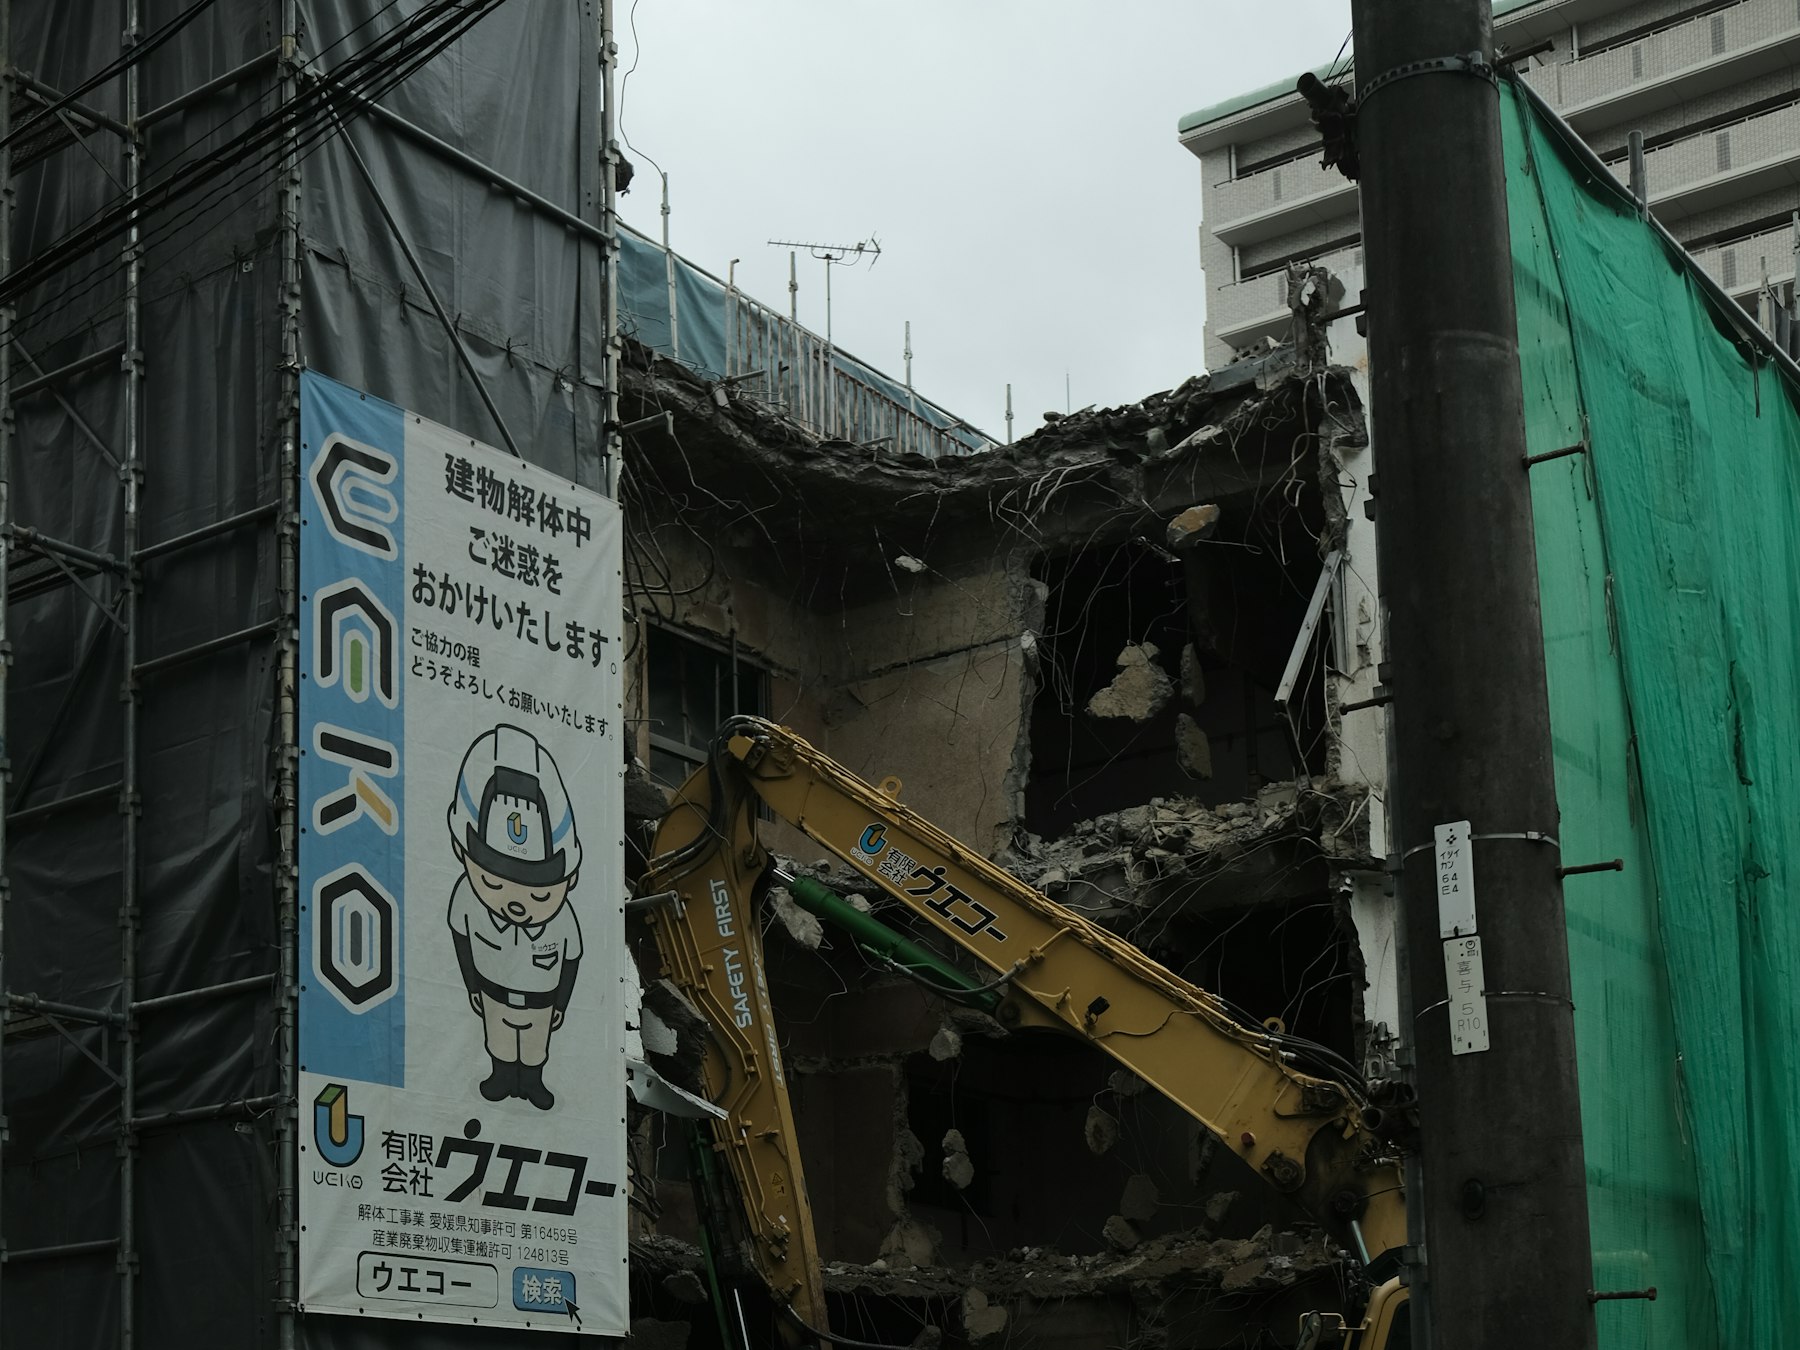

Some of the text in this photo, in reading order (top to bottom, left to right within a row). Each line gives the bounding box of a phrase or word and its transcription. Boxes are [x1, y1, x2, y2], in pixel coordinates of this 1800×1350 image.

[444, 453, 591, 548] 建物解体中
[468, 525, 564, 596] ご迷惑を
[412, 562, 617, 675] おかけいたします。
[411, 627, 481, 669] ご協力の程
[1442, 872, 1458, 883] 64
[1442, 884, 1459, 895] E4
[904, 865, 1008, 943] ウエコー
[710, 878, 752, 1029] SAFETY FIRST
[1457, 1017, 1480, 1031] R10
[1462, 1002, 1474, 1015] 5
[381, 1129, 434, 1167] 有限
[381, 1162, 434, 1198] 会社
[435, 1119, 617, 1217] ウエコー
[357, 1203, 425, 1228] 解体工事業
[429, 1212, 516, 1238] 愛媛県知事許可
[372, 1261, 472, 1295] ウエコー
[522, 1274, 563, 1306] 検索
